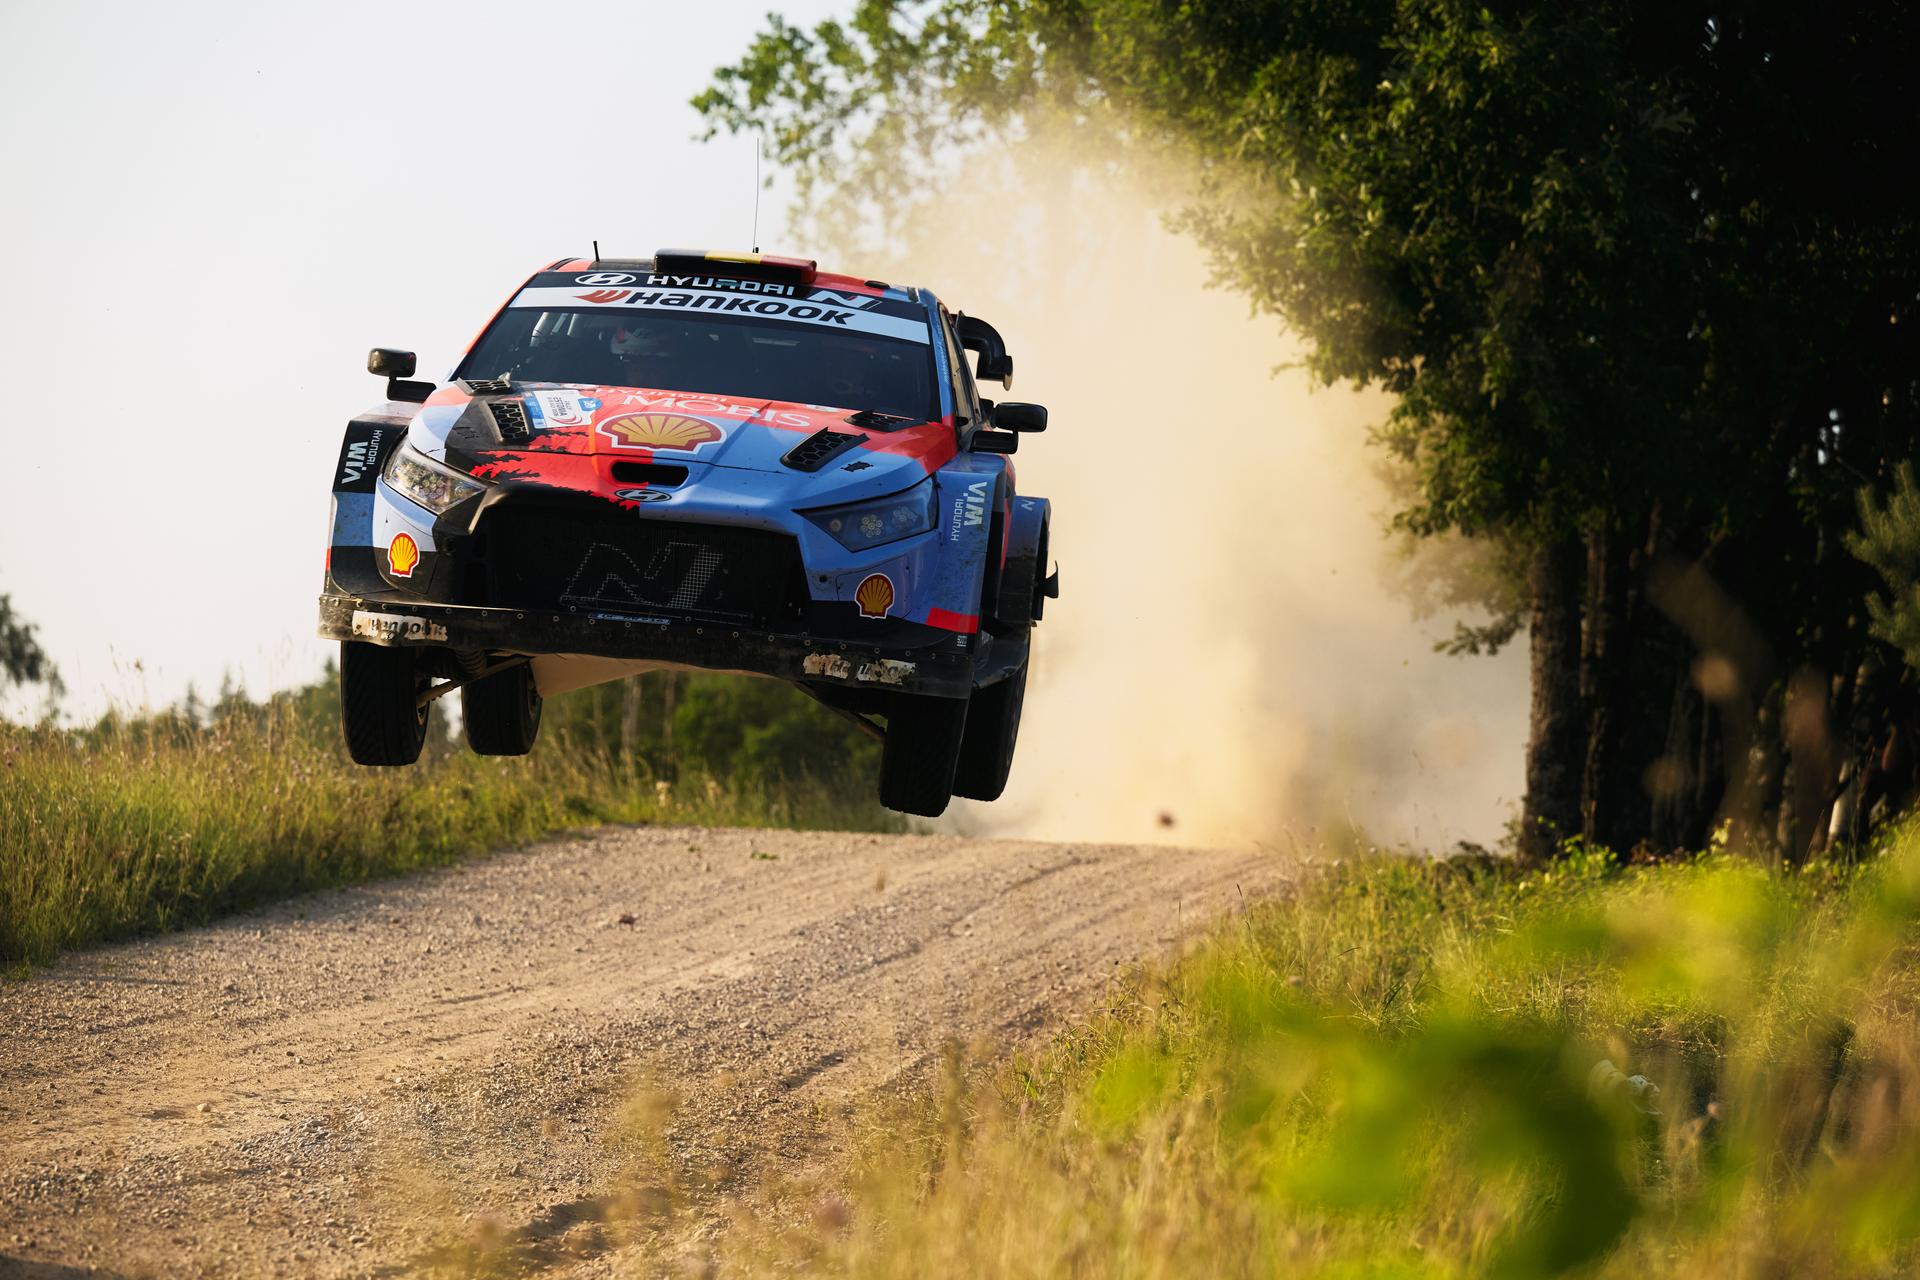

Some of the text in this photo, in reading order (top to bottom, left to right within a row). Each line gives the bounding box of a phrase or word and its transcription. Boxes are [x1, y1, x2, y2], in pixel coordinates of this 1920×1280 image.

[646, 274, 795, 296] HYUNDAI
[621, 394, 812, 427] MOBIS
[366, 429, 383, 465] HYUNDAI
[951, 498, 964, 541] HYUNDAI
